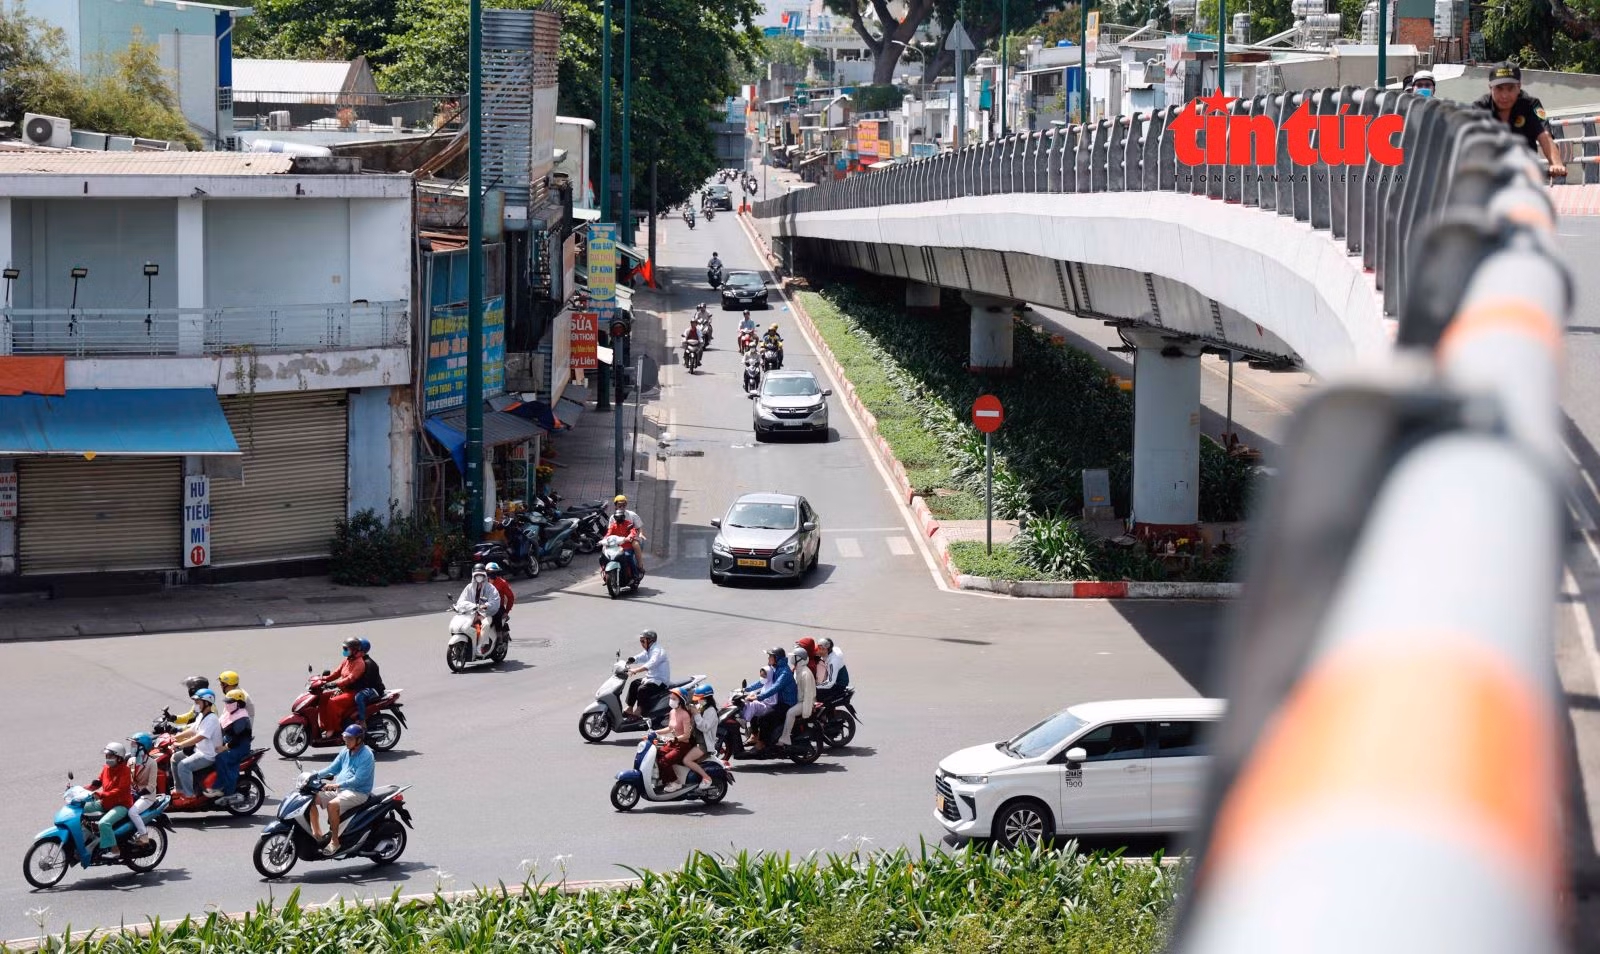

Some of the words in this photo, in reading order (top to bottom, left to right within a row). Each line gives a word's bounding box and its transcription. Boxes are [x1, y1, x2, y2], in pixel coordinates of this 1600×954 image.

[190, 476, 205, 498] HỦ
[185, 499, 210, 521] TIẾU
[193, 549, 203, 562] 11
